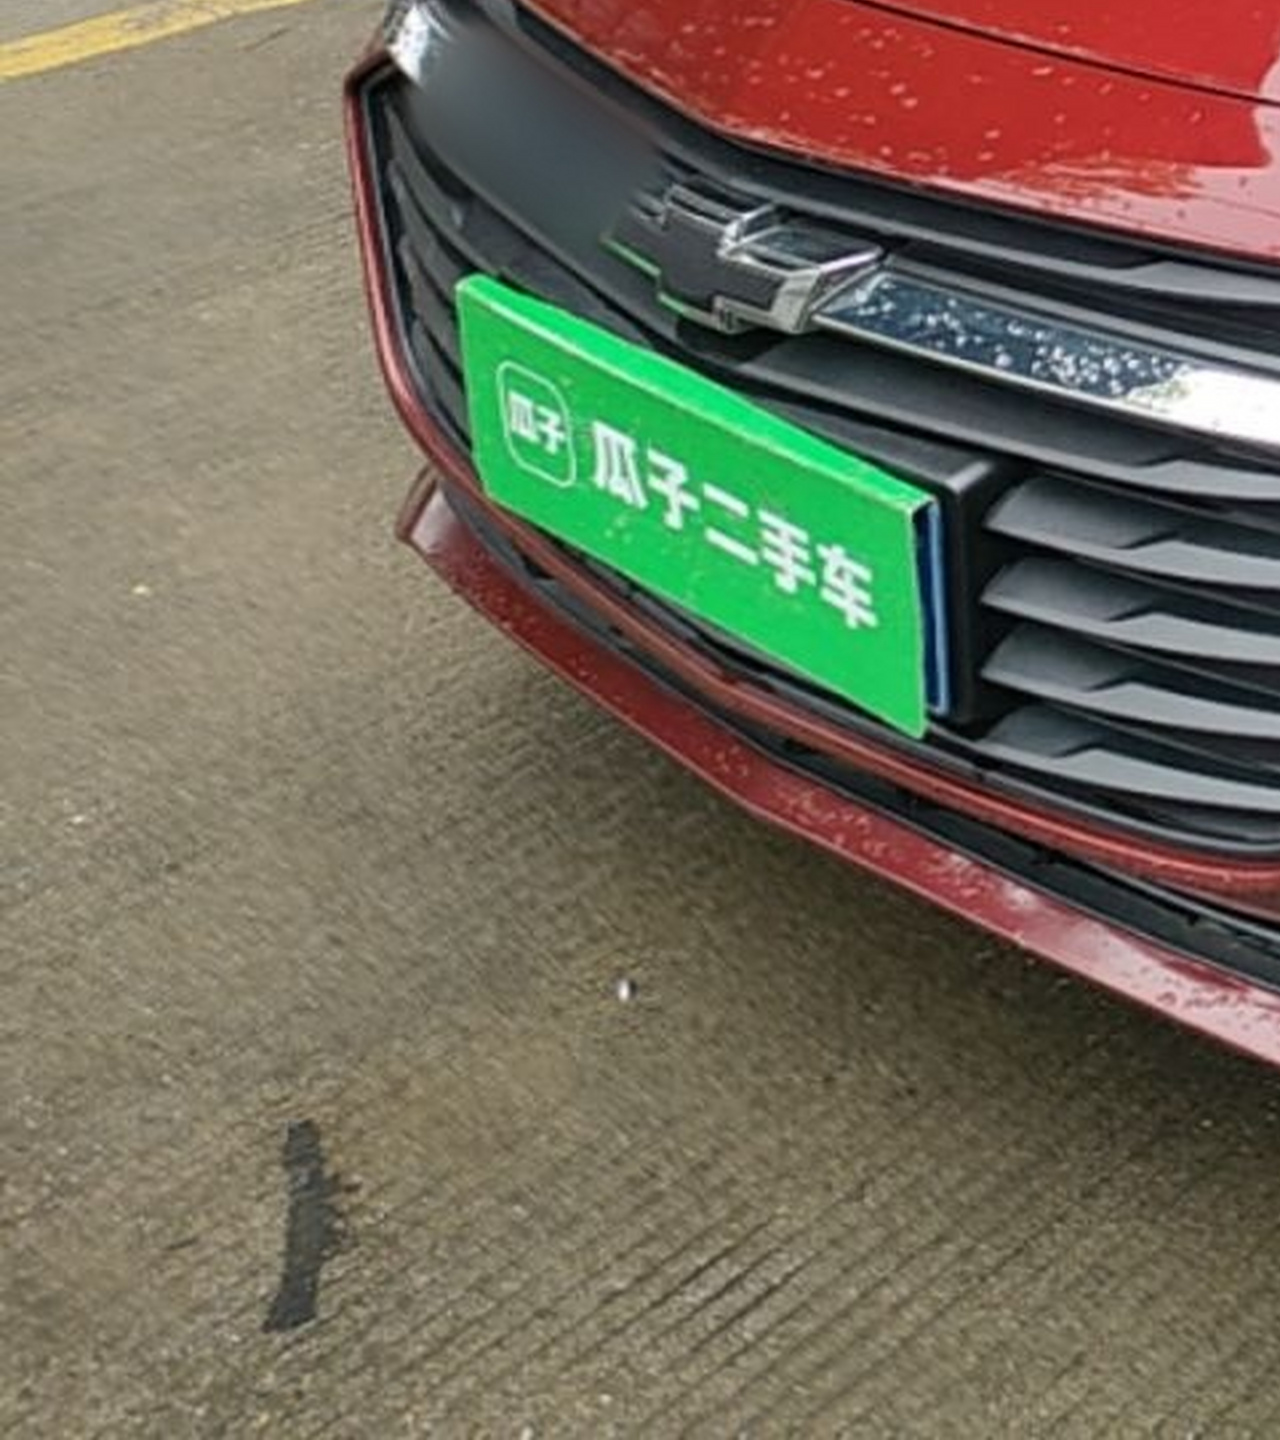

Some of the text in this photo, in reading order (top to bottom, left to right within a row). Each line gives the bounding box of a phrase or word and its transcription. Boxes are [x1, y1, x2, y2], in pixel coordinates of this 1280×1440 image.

[508, 389, 566, 454] 瓜子
[591, 420, 878, 629] 瓜子二手车
